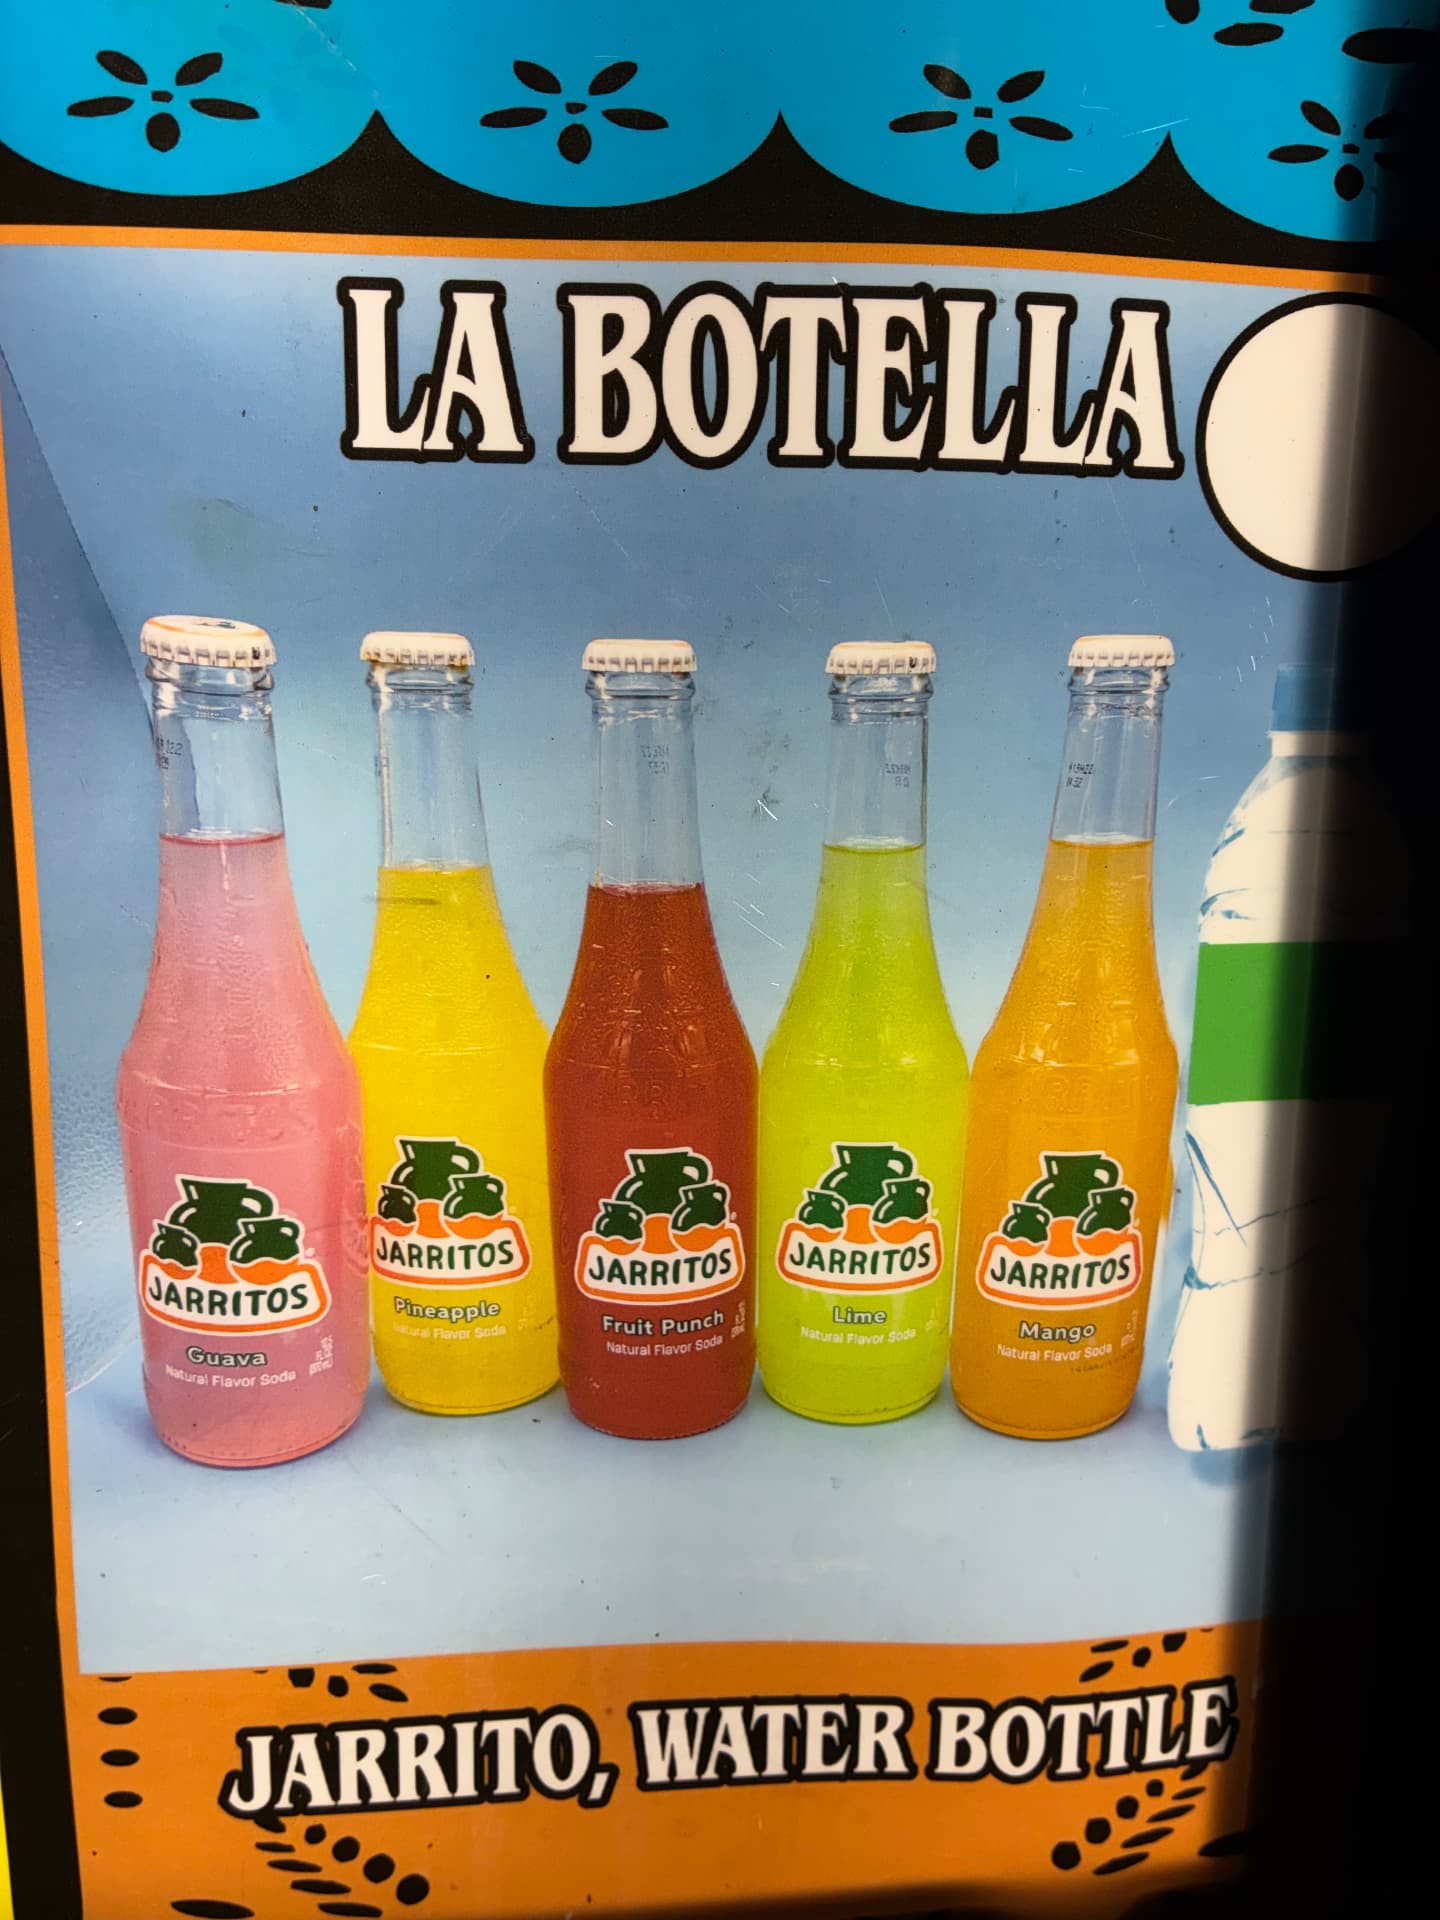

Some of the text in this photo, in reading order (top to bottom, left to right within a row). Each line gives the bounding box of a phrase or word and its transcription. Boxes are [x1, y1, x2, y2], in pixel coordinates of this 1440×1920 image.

[340, 279, 1182, 478] LA BOTELLA
[376, 1237, 515, 1270] JARRITOS
[790, 1241, 931, 1275] JARRITOS
[588, 1248, 732, 1286] JARRITOS
[991, 1254, 1131, 1290] JARRITOS
[149, 1277, 308, 1317] JARRITOS
[394, 1297, 501, 1323] Pineapple
[602, 1315, 653, 1336] Fruit
[661, 1309, 725, 1336] Punch
[833, 1306, 886, 1324] Lime
[433, 1327, 470, 1340] Flavor
[474, 1324, 506, 1339] Soda
[606, 1334, 724, 1356] Natural Flavor Soda
[800, 1326, 916, 1345] Natural Flavor Soda
[1019, 1320, 1096, 1344] Mango
[187, 1346, 267, 1367] Guava
[997, 1343, 1113, 1362] Natural Flavor Soda
[165, 1364, 297, 1388] Natural Flavor Soda
[224, 1683, 1236, 1813] JARRITO, WATER BOTTLE
